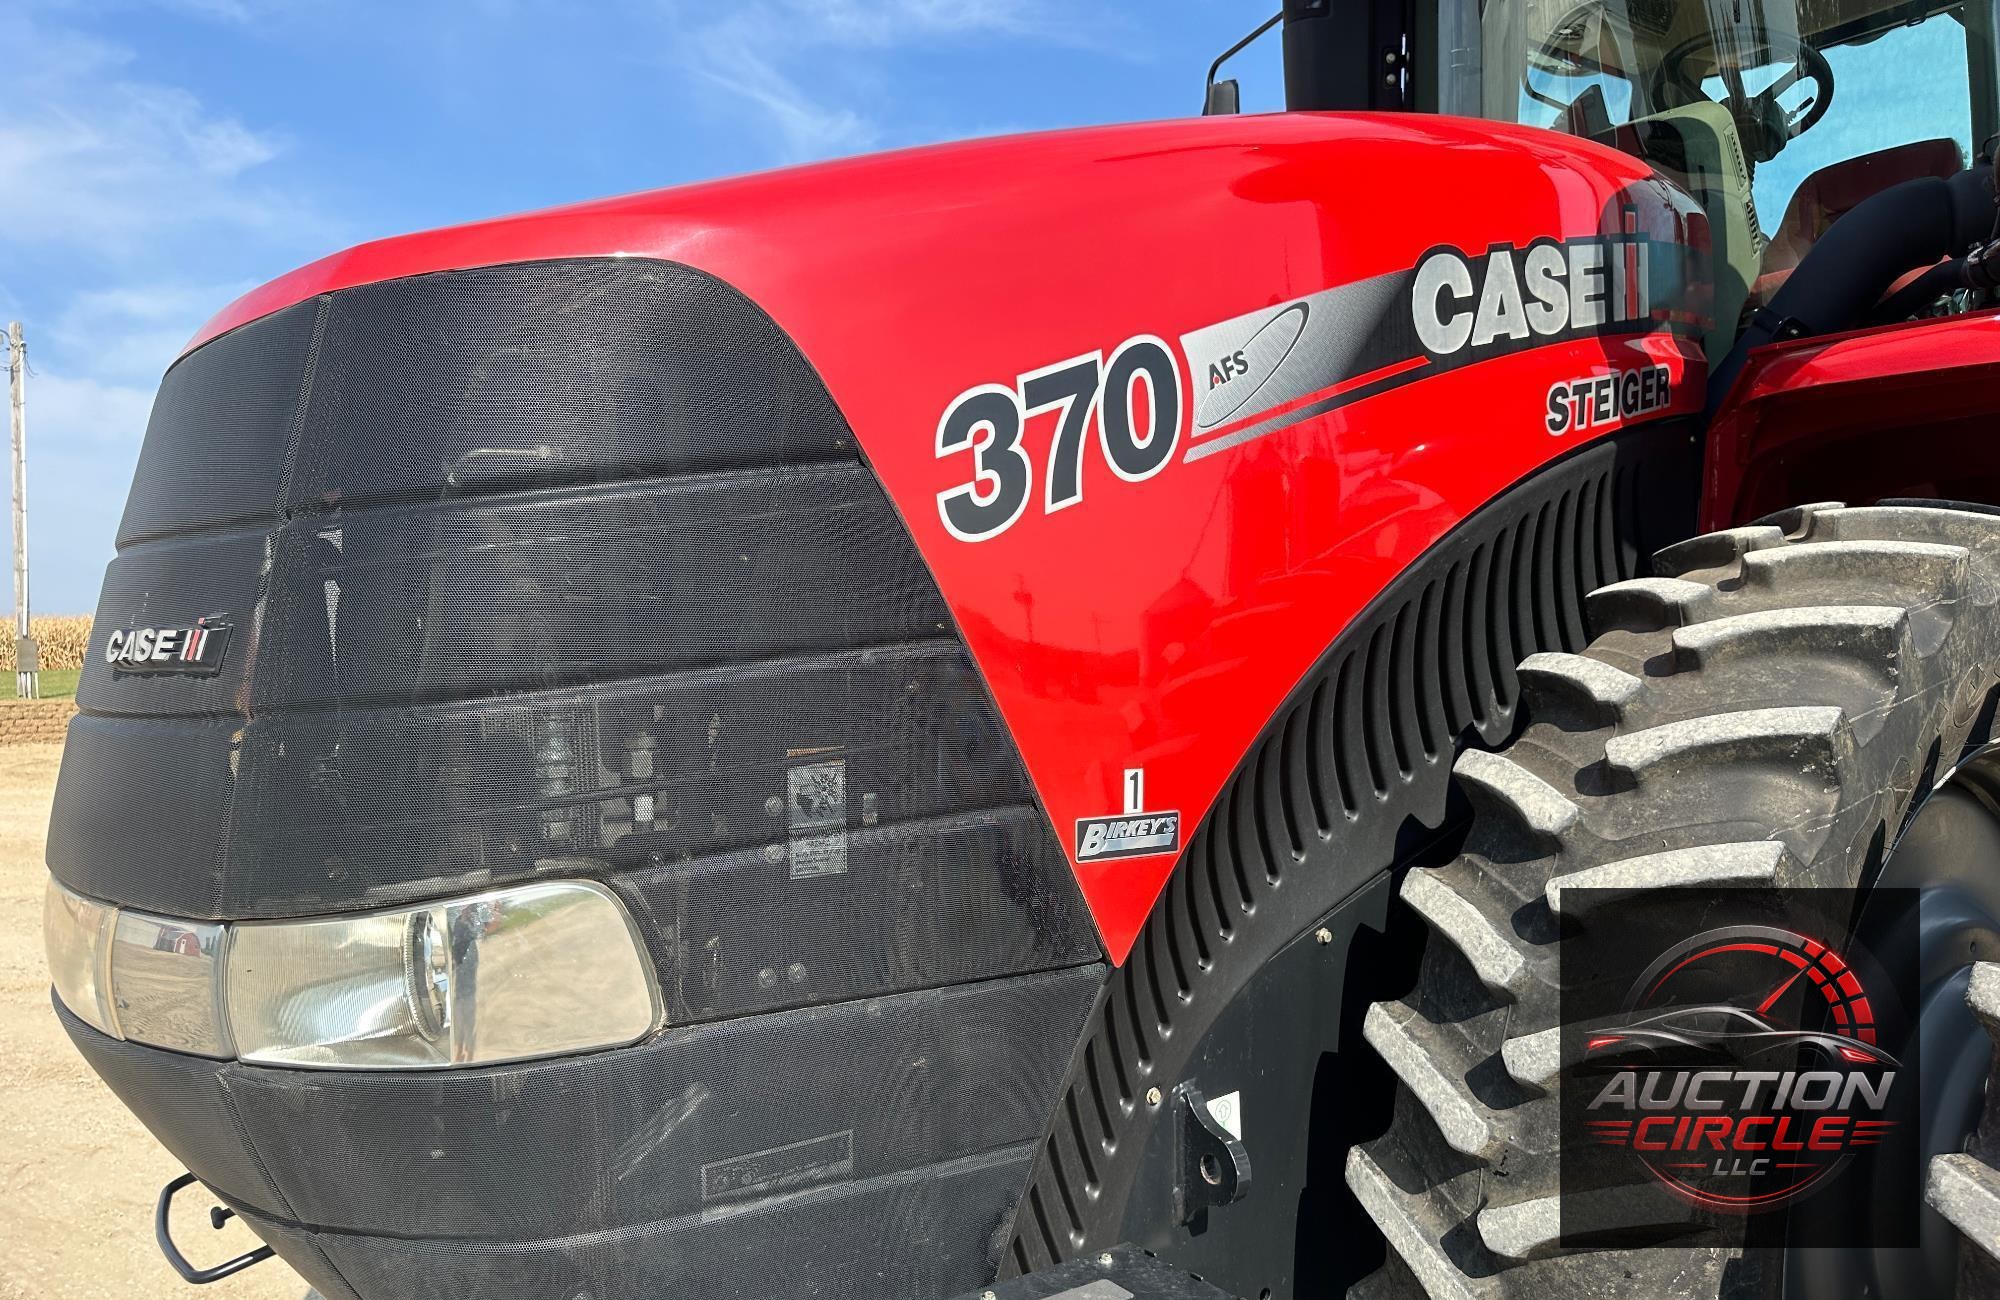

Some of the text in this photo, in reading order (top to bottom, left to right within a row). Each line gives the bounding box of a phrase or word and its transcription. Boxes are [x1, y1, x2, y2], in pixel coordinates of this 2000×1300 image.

[1411, 244, 1606, 355] CASE
[1208, 350, 1249, 391] AFS
[1545, 364, 1672, 437] STEIGER
[935, 333, 1183, 543] 370
[105, 628, 177, 663] CASE
[1129, 771, 1139, 810] 1
[1078, 816, 1178, 858] BIRKEY'S
